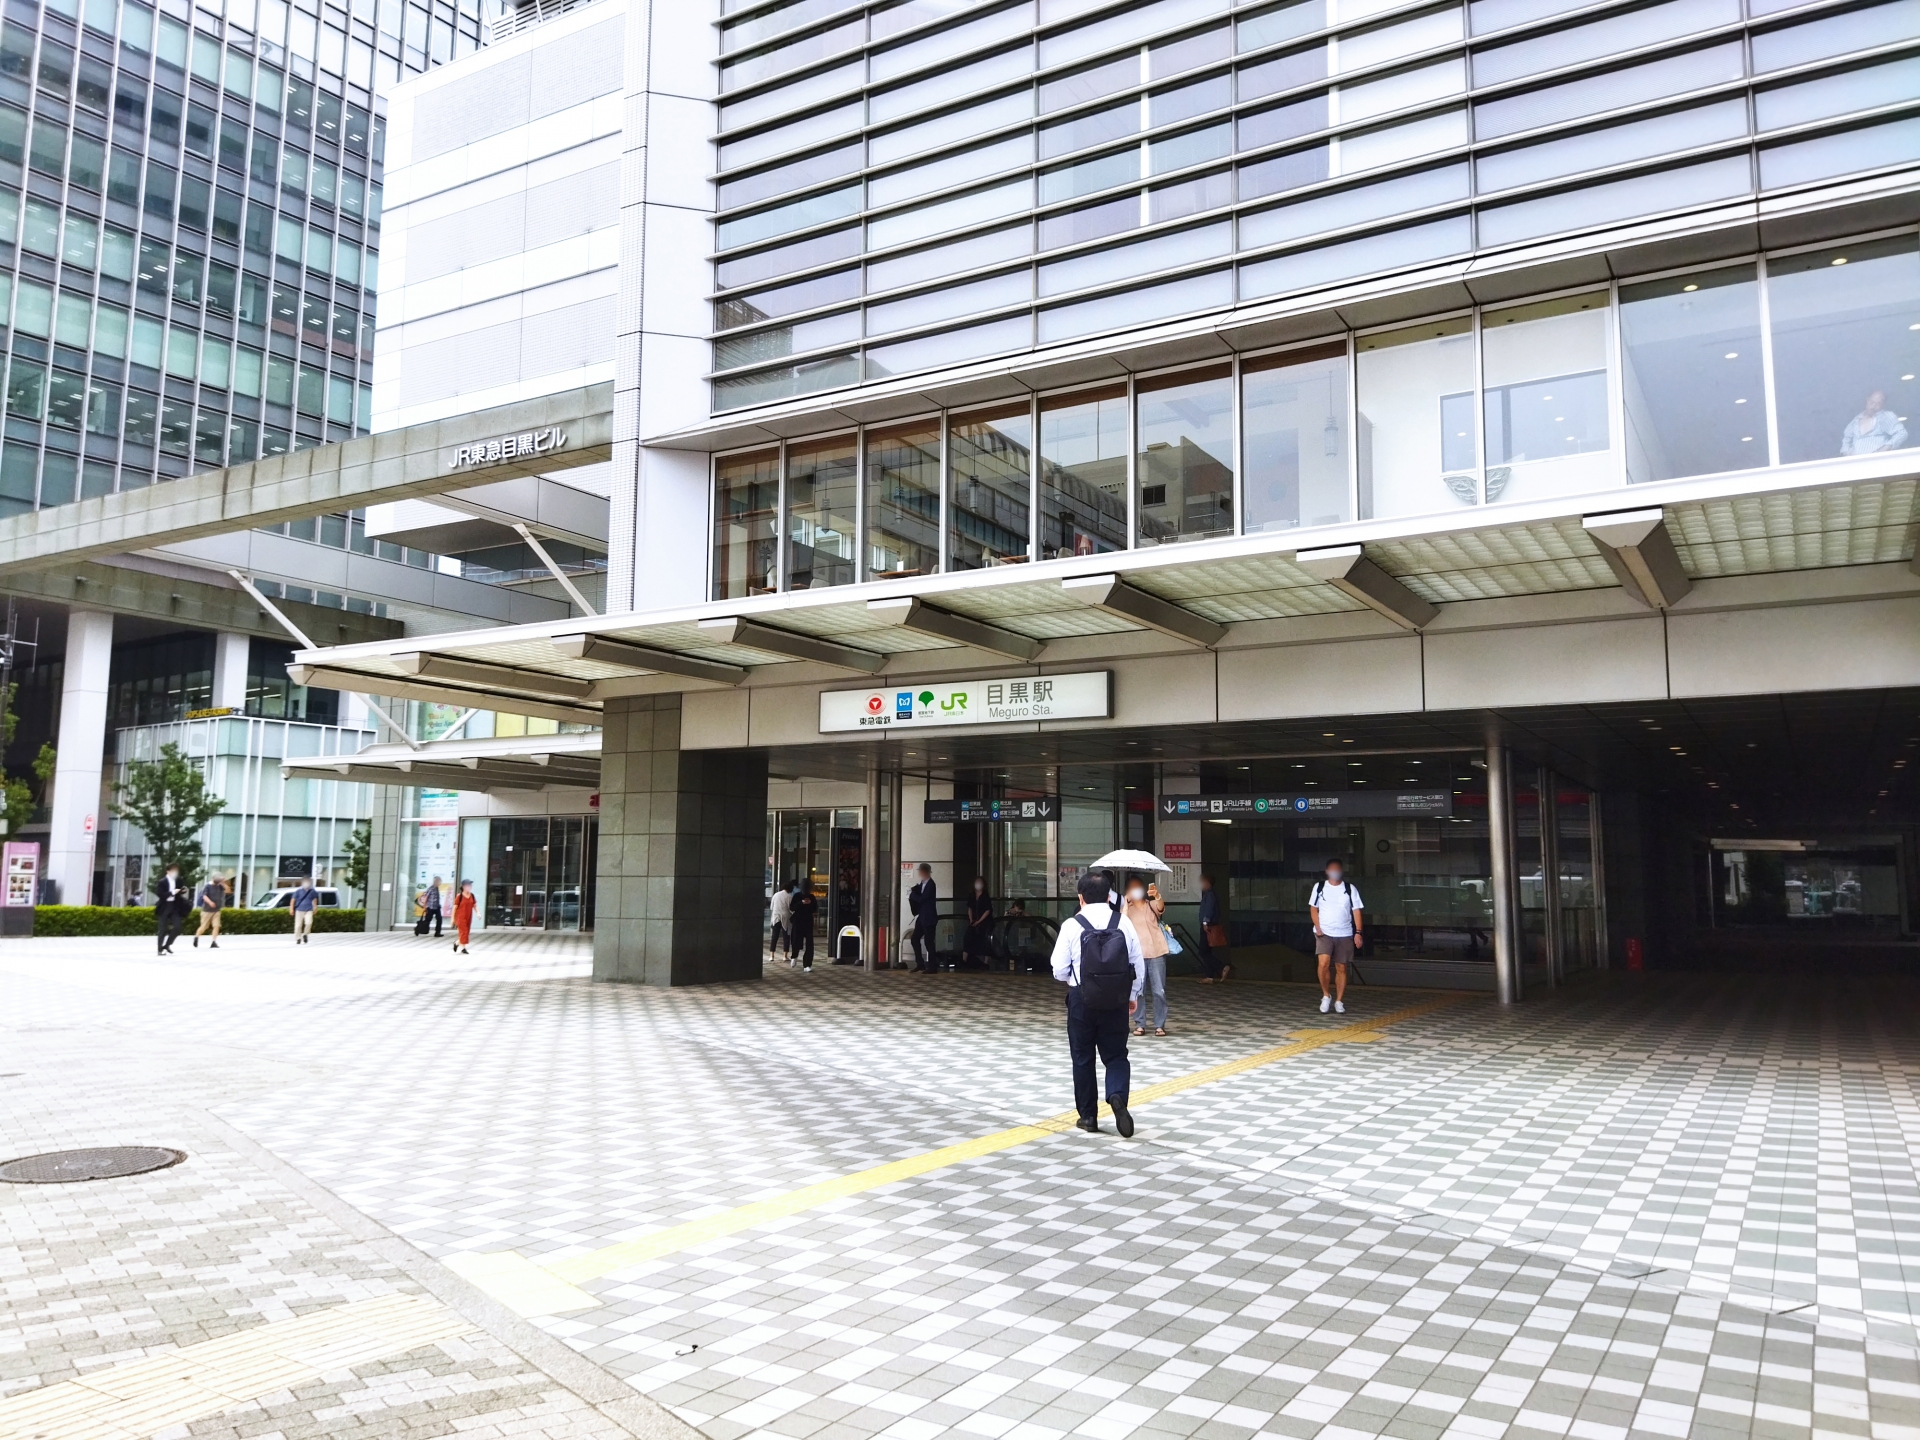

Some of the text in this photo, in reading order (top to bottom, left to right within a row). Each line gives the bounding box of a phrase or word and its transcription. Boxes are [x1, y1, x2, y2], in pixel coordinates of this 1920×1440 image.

[448, 427, 567, 468] JR東急目黒ビル
[941, 692, 968, 710] JR
[987, 680, 1053, 706] 目黒駅
[989, 704, 1054, 720] Meguro Sta.
[859, 716, 891, 726] 東急電鉄
[1223, 799, 1251, 807] JR山手線
